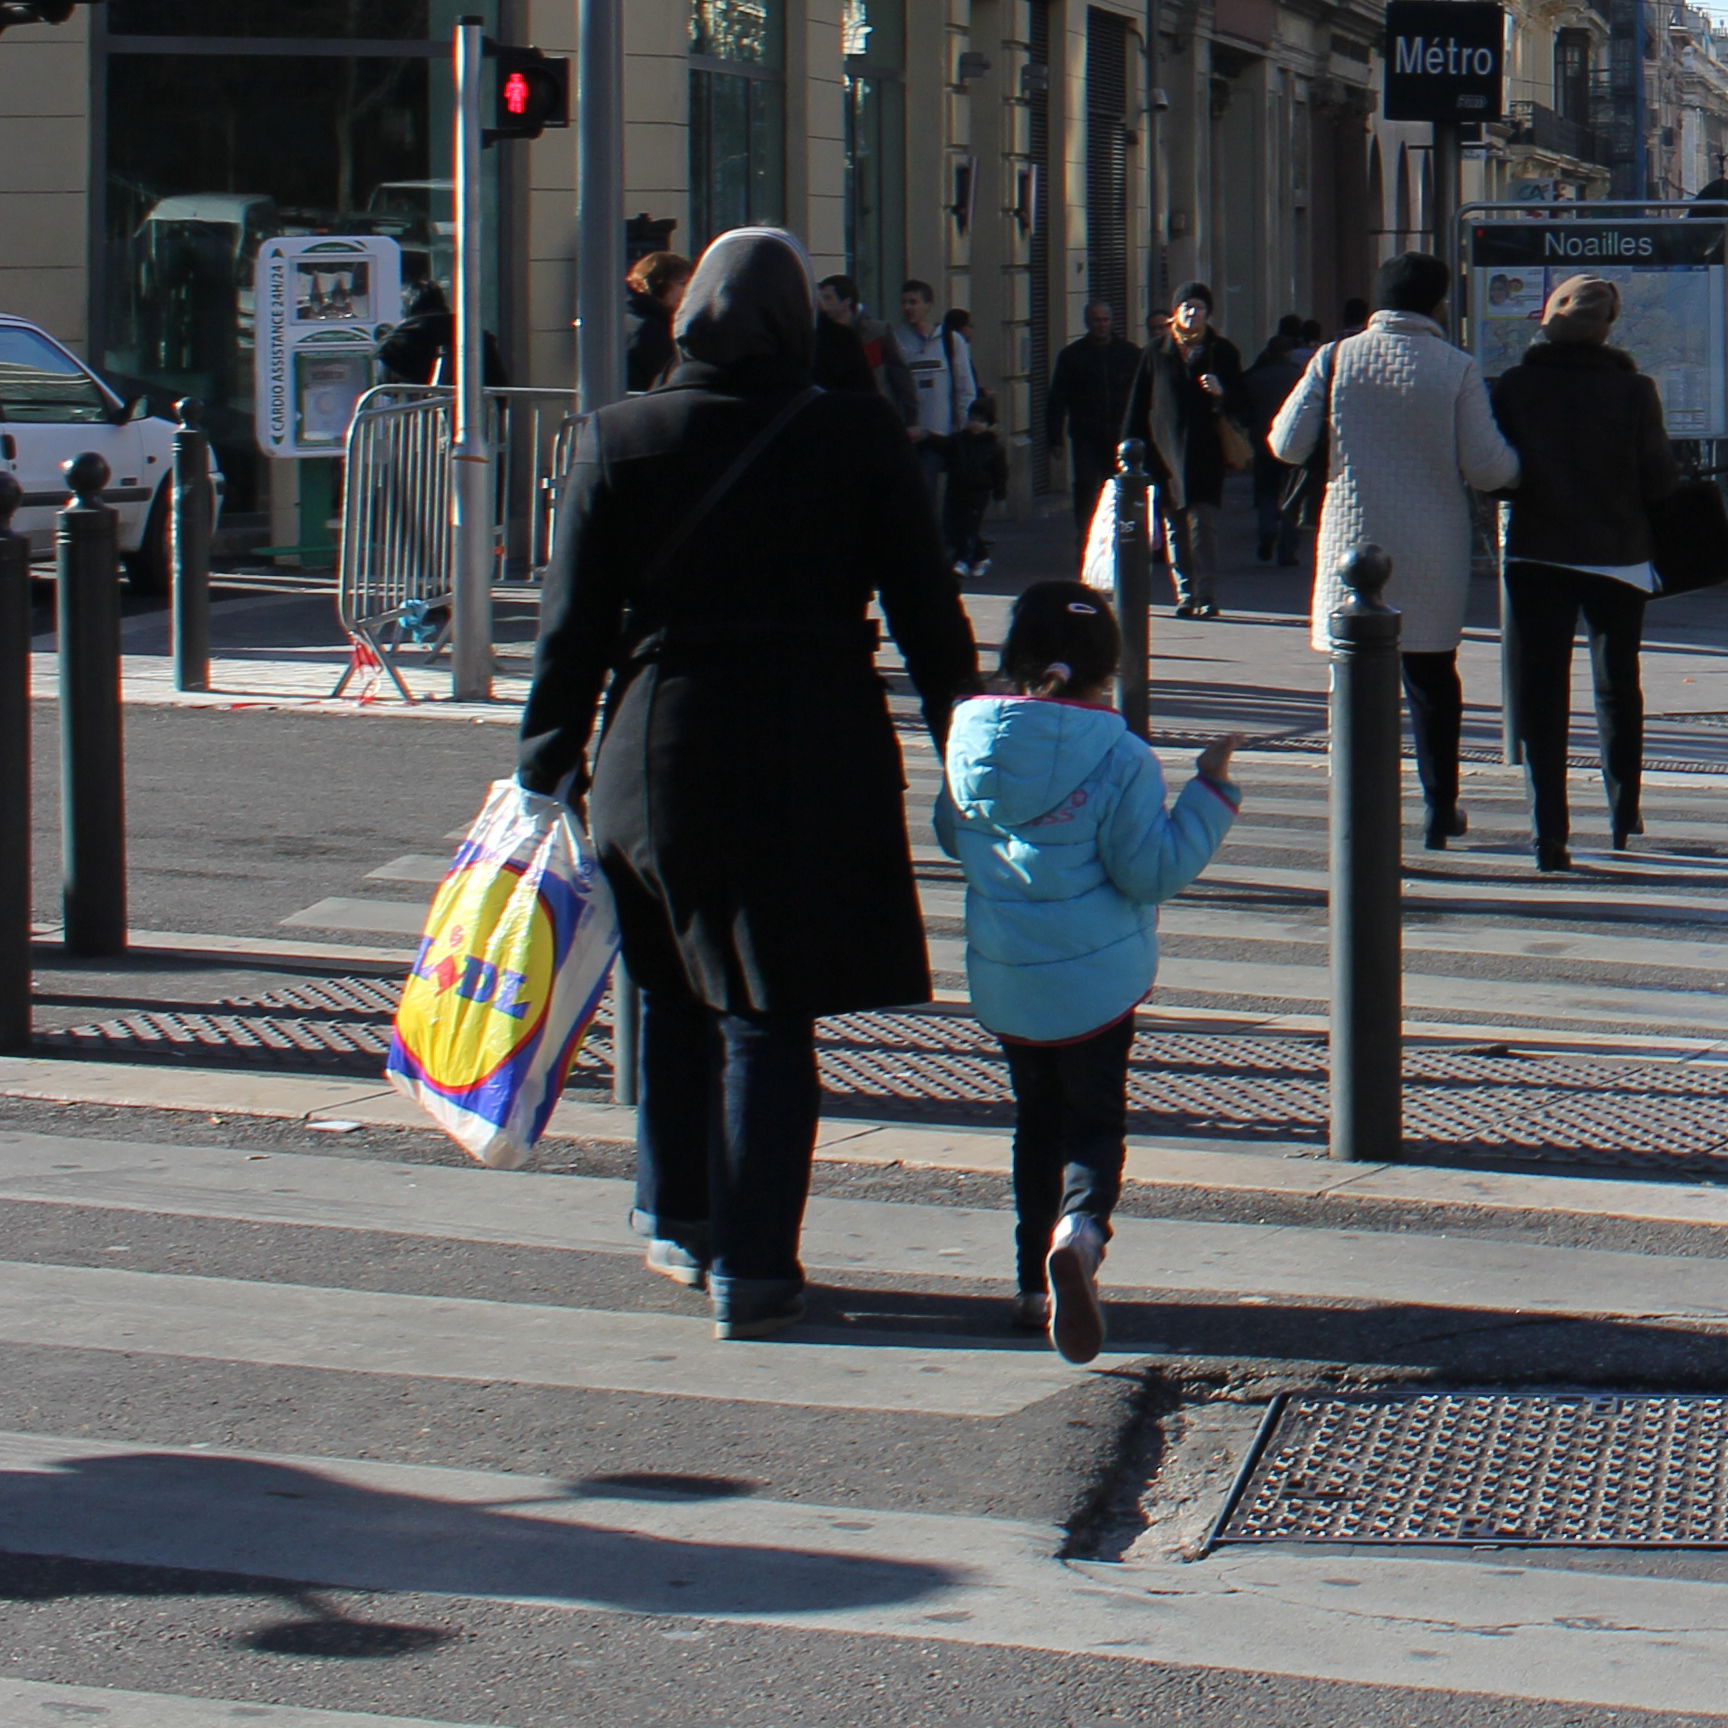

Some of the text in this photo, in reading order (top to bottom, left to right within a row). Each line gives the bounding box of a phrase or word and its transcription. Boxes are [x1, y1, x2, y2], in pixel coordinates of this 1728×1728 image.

[1394, 35, 1494, 75] Métro
[1544, 231, 1653, 256] Noailles
[271, 265, 285, 432] CARDIO ASSISTANCE 24H/24
